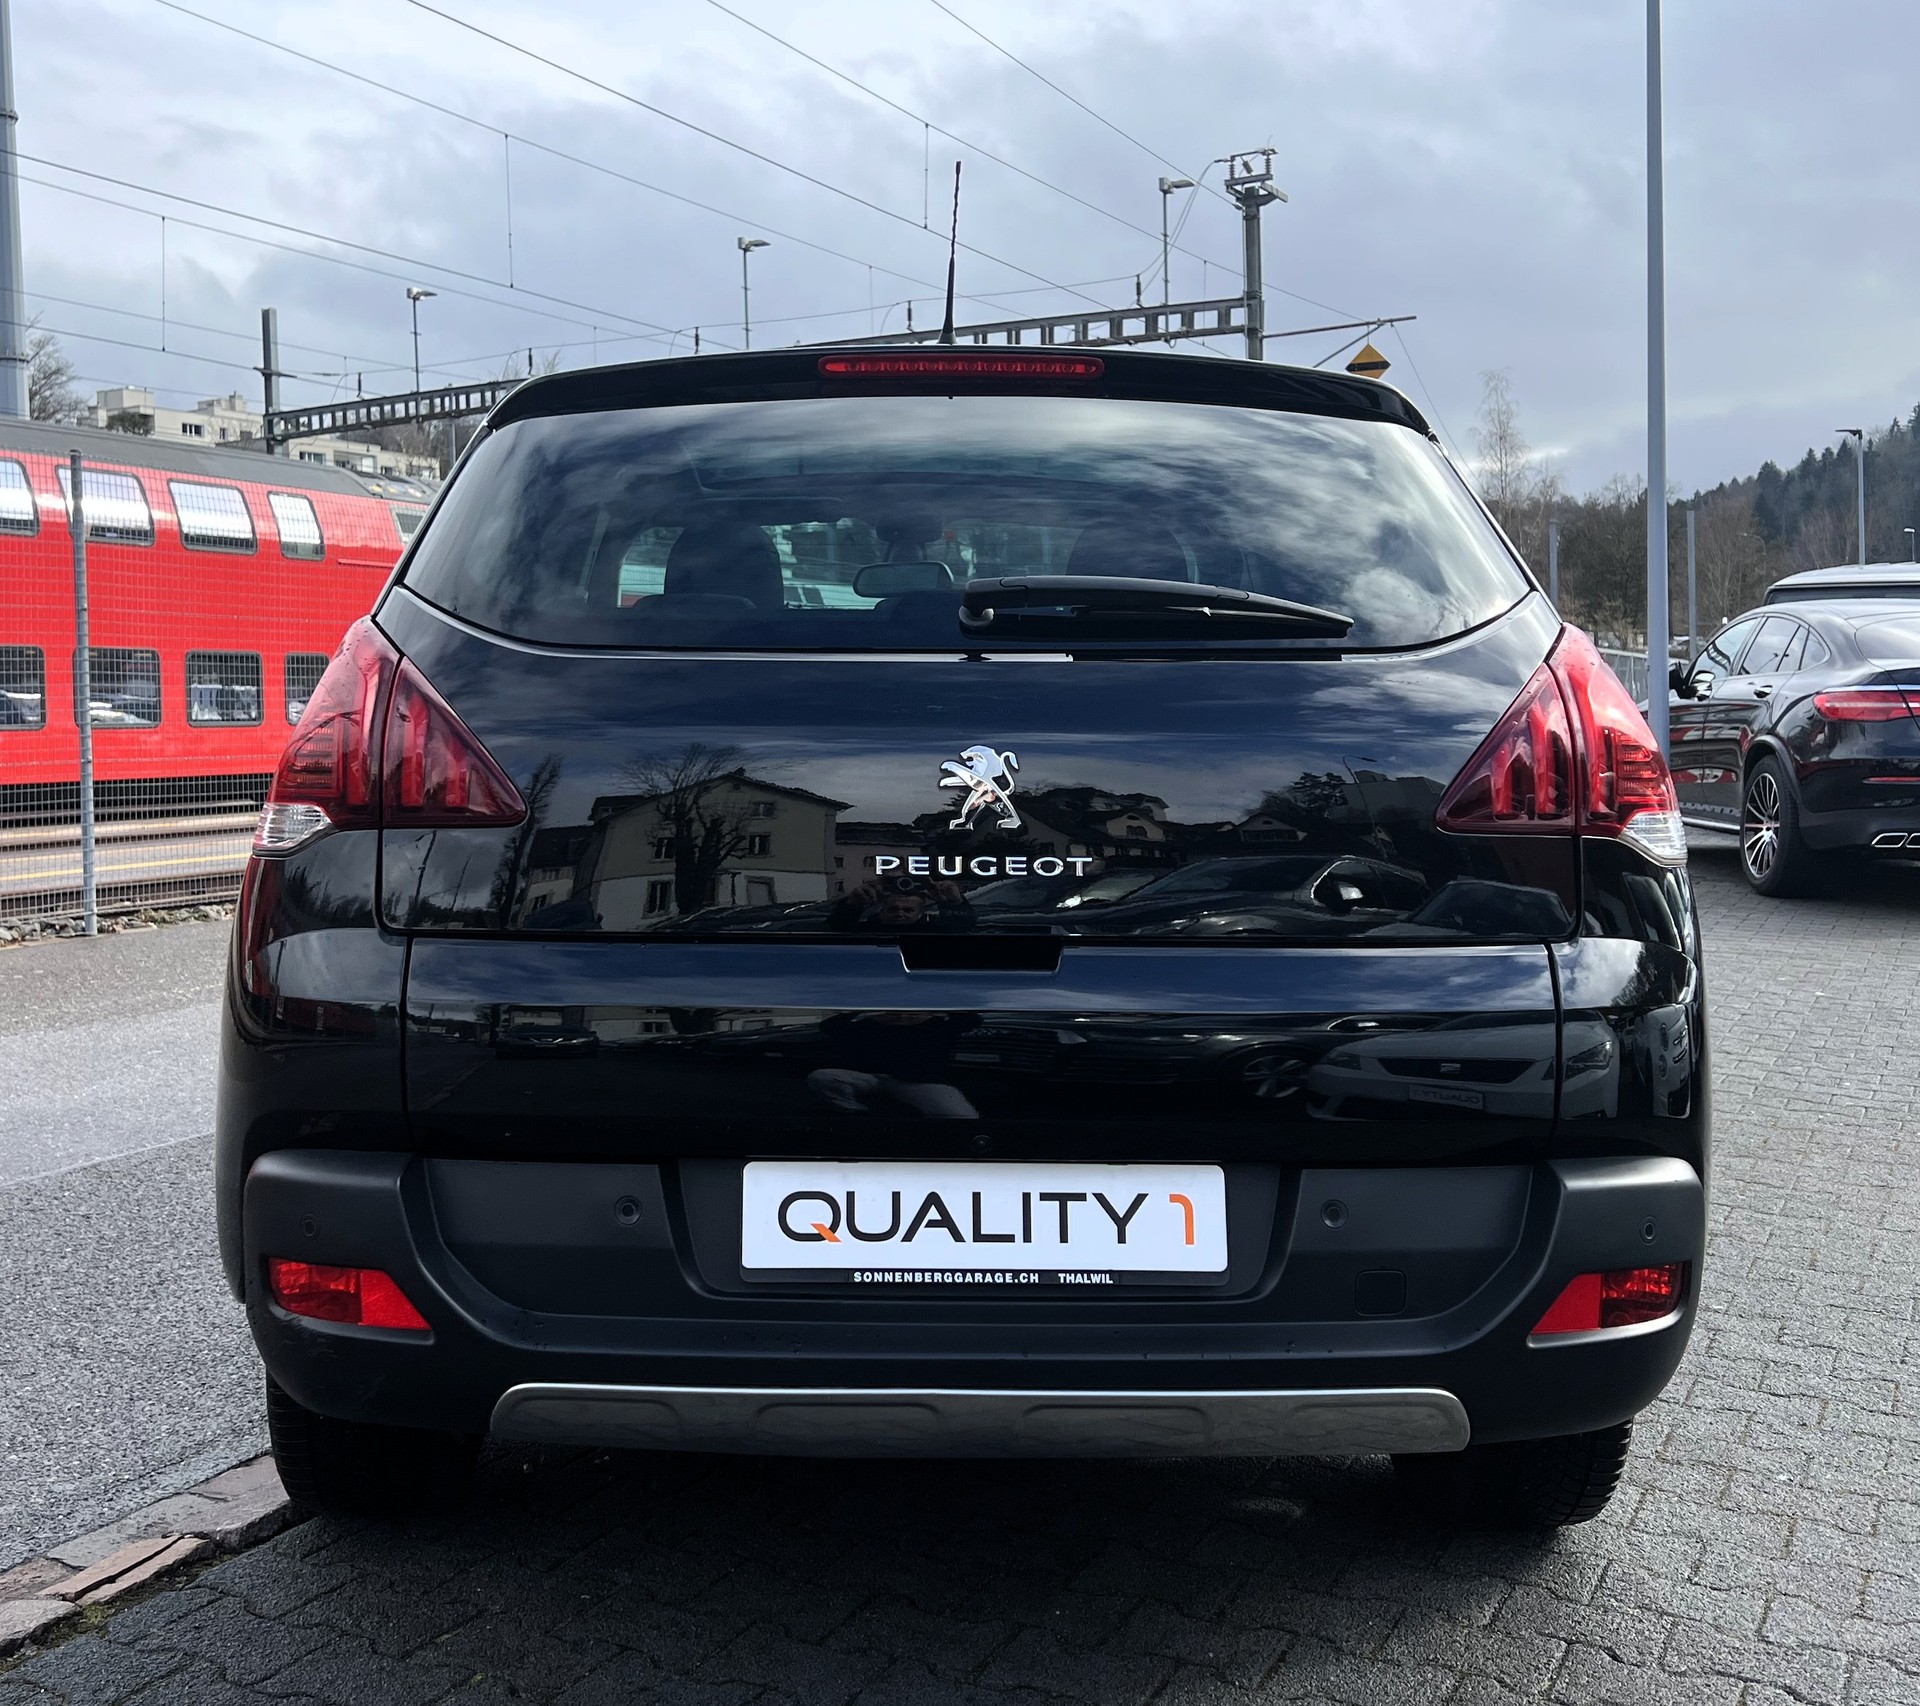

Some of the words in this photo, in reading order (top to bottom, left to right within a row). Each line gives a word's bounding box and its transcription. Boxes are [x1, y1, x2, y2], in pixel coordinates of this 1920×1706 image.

[875, 855, 1093, 877] PEUGEOT
[777, 1190, 1149, 1245] QUALITY
[1169, 1193, 1195, 1245] 1
[853, 1271, 1040, 1284] SONNENBERGGARAGE.CH
[1058, 1272, 1114, 1285] THALWIL
